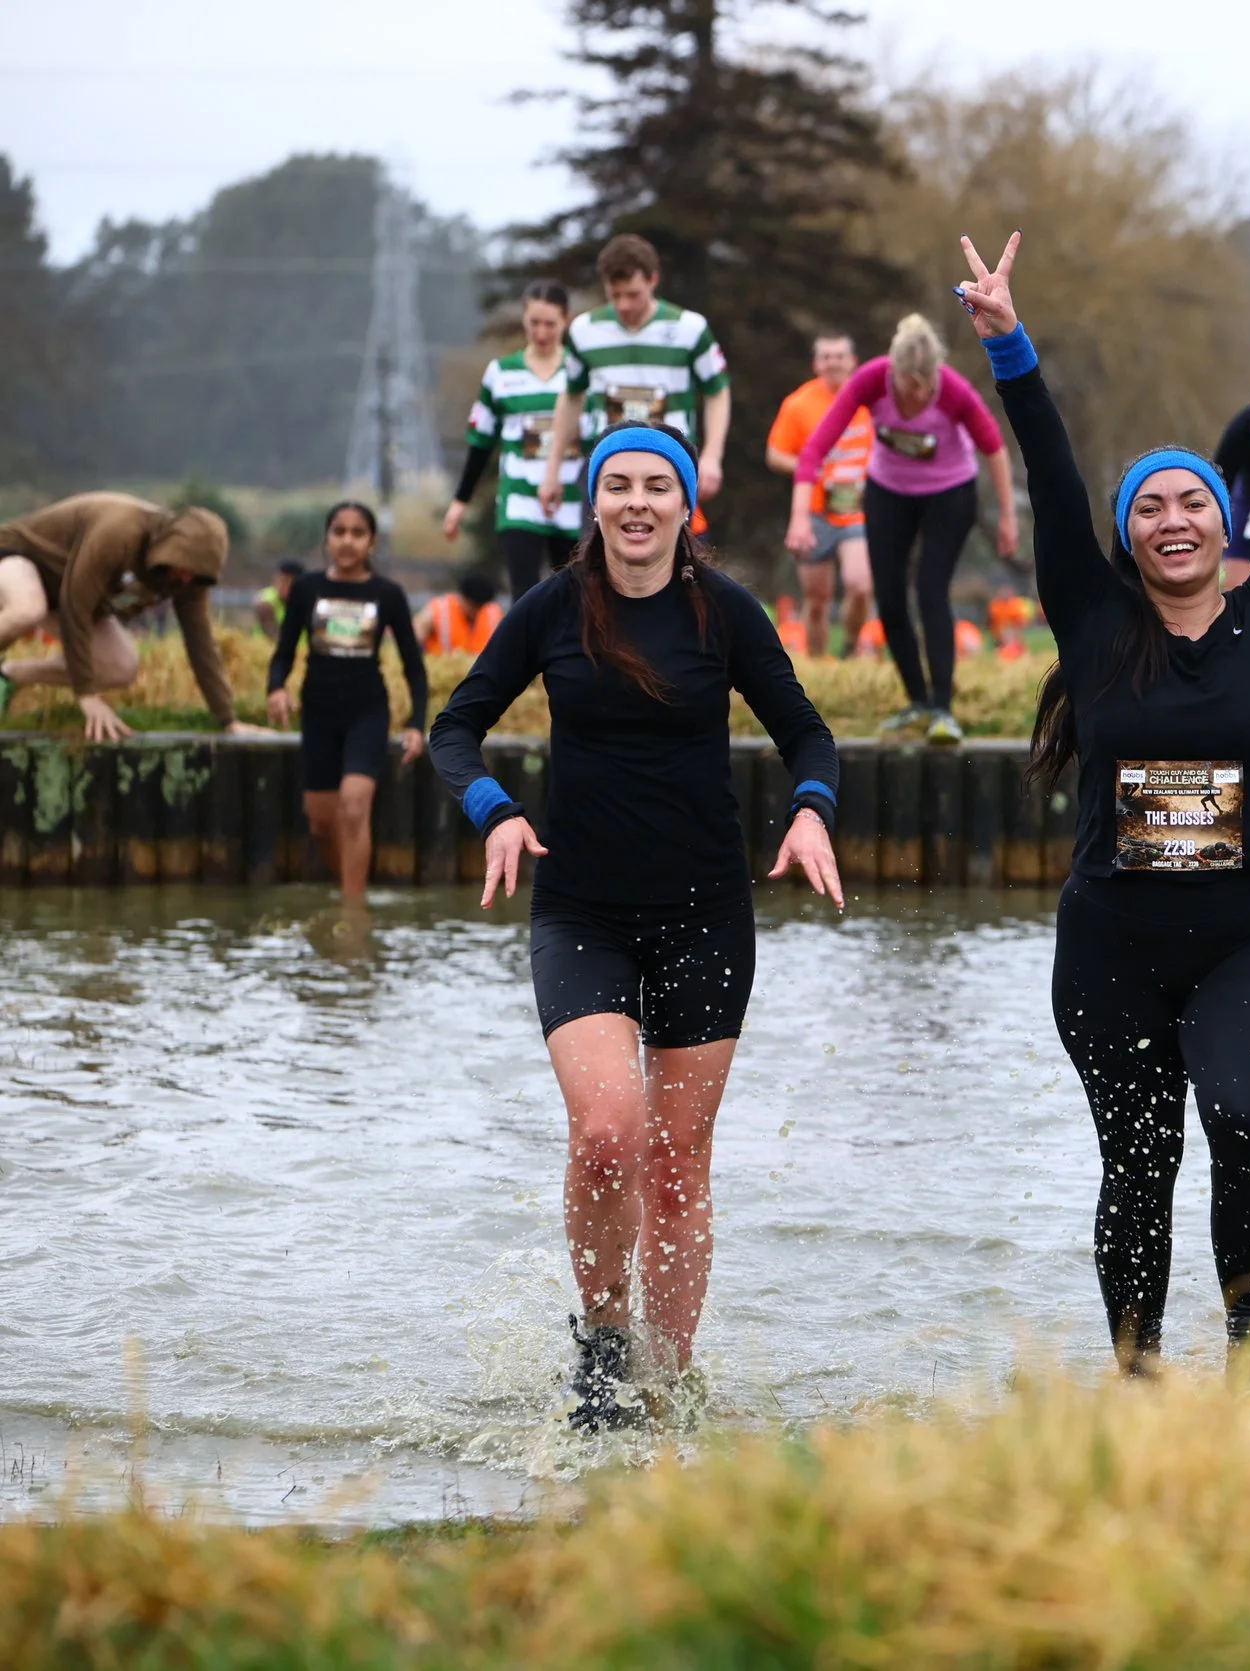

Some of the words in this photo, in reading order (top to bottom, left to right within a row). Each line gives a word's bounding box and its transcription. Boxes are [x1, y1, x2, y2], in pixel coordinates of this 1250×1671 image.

[1149, 775, 1209, 785] CHALLENGE
[1144, 810, 1168, 825] THE
[1169, 810, 1215, 826] BOSSES
[1163, 839, 1196, 856] 223B
